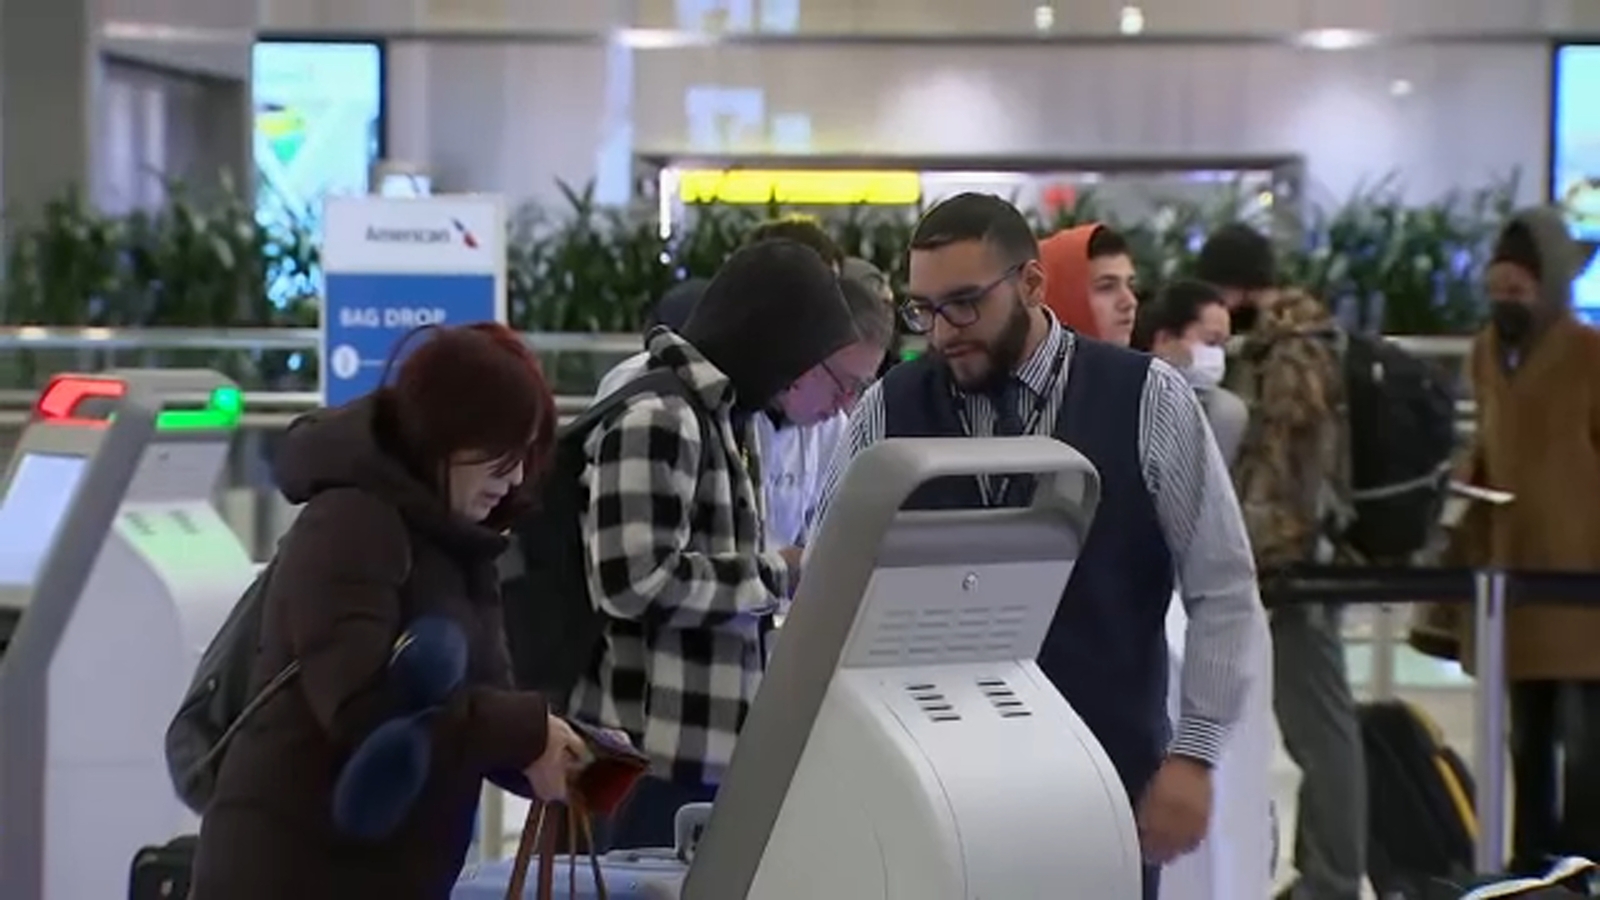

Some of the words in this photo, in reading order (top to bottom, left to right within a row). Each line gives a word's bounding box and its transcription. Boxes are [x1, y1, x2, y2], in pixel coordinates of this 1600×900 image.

[366, 225, 450, 243] American
[340, 308, 380, 327] BAG
[384, 308, 446, 327] DROP
